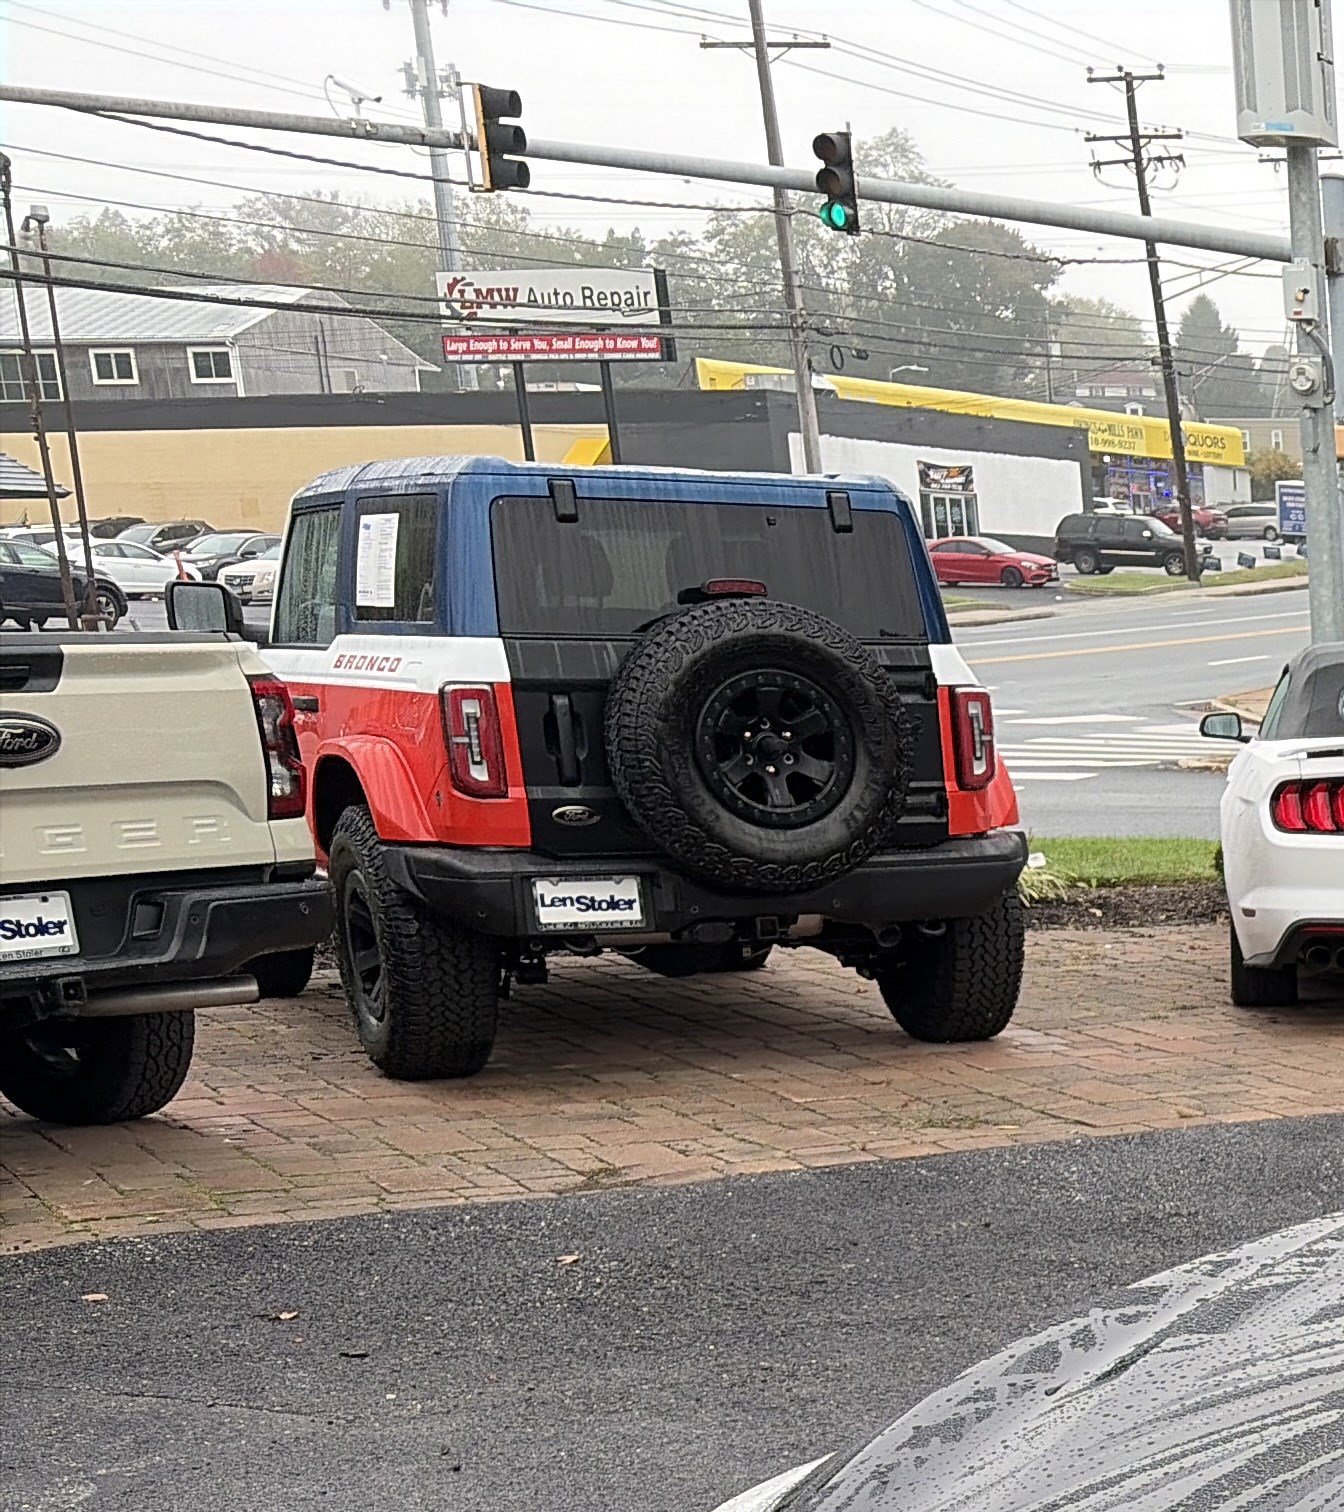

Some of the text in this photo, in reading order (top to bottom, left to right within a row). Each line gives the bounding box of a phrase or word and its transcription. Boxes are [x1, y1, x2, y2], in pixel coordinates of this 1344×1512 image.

[457, 285, 651, 311] LMW Auto Repair
[447, 339, 468, 353] Large
[469, 339, 498, 353] Enough
[500, 339, 508, 350] to
[510, 338, 531, 351] Serve
[552, 337, 573, 350] Small
[575, 336, 604, 352] Enough
[605, 338, 615, 349] to
[616, 337, 638, 349] Know
[640, 336, 658, 349] You!
[333, 654, 402, 672] BRONCO
[564, 808, 589, 821] Ford
[1, 952, 14, 960] en
